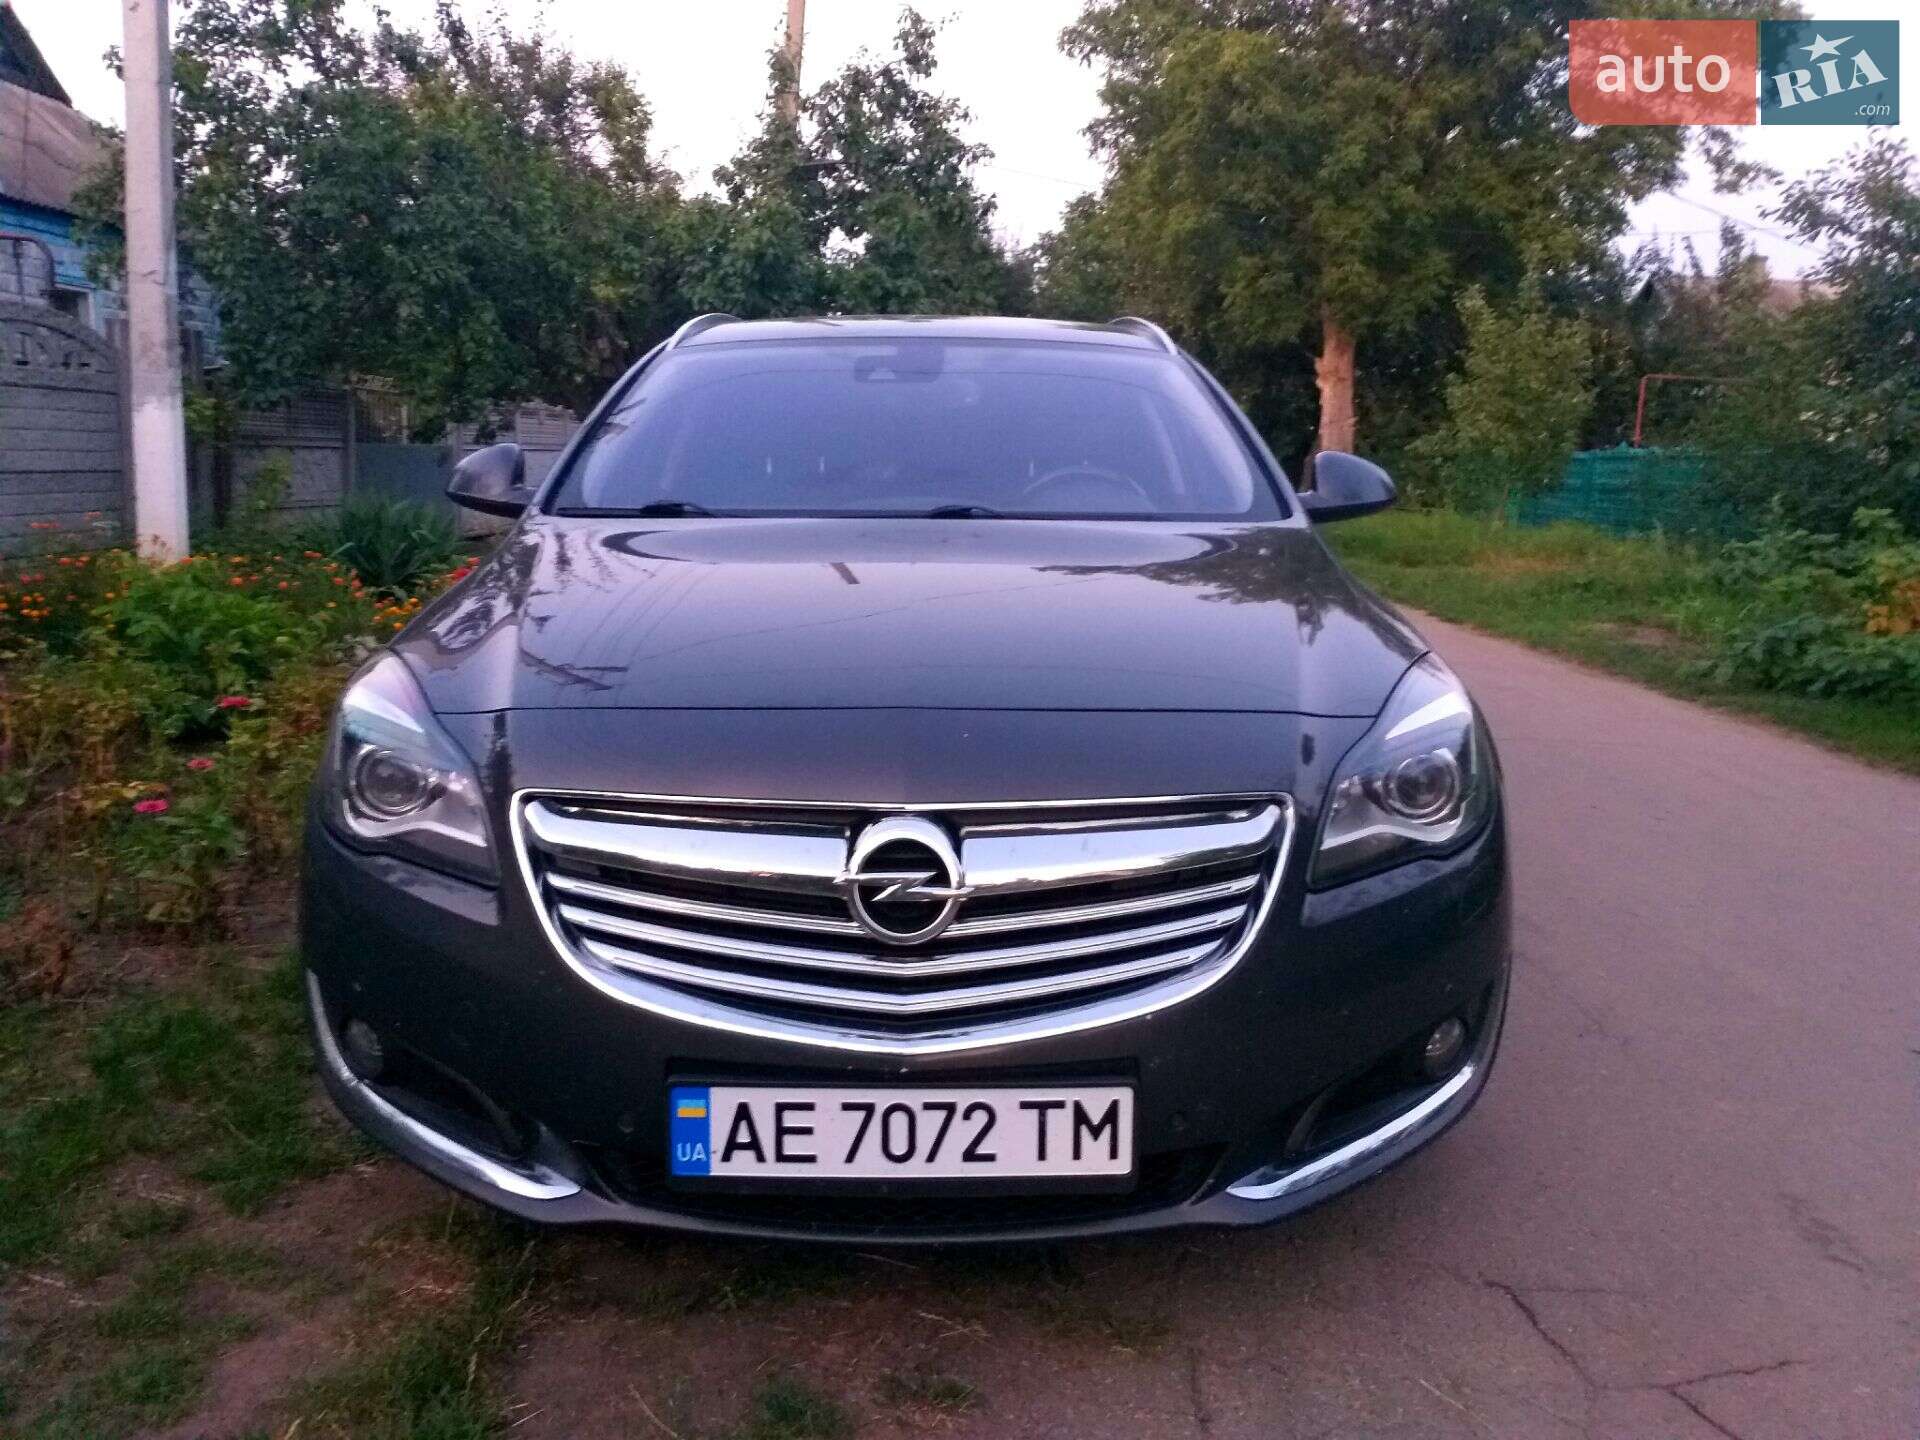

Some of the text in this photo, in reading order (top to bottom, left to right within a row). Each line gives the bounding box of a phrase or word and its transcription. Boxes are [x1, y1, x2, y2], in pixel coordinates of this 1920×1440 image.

[676, 1142, 708, 1163] UA
[720, 1099, 1120, 1164] AE 7072 TM
